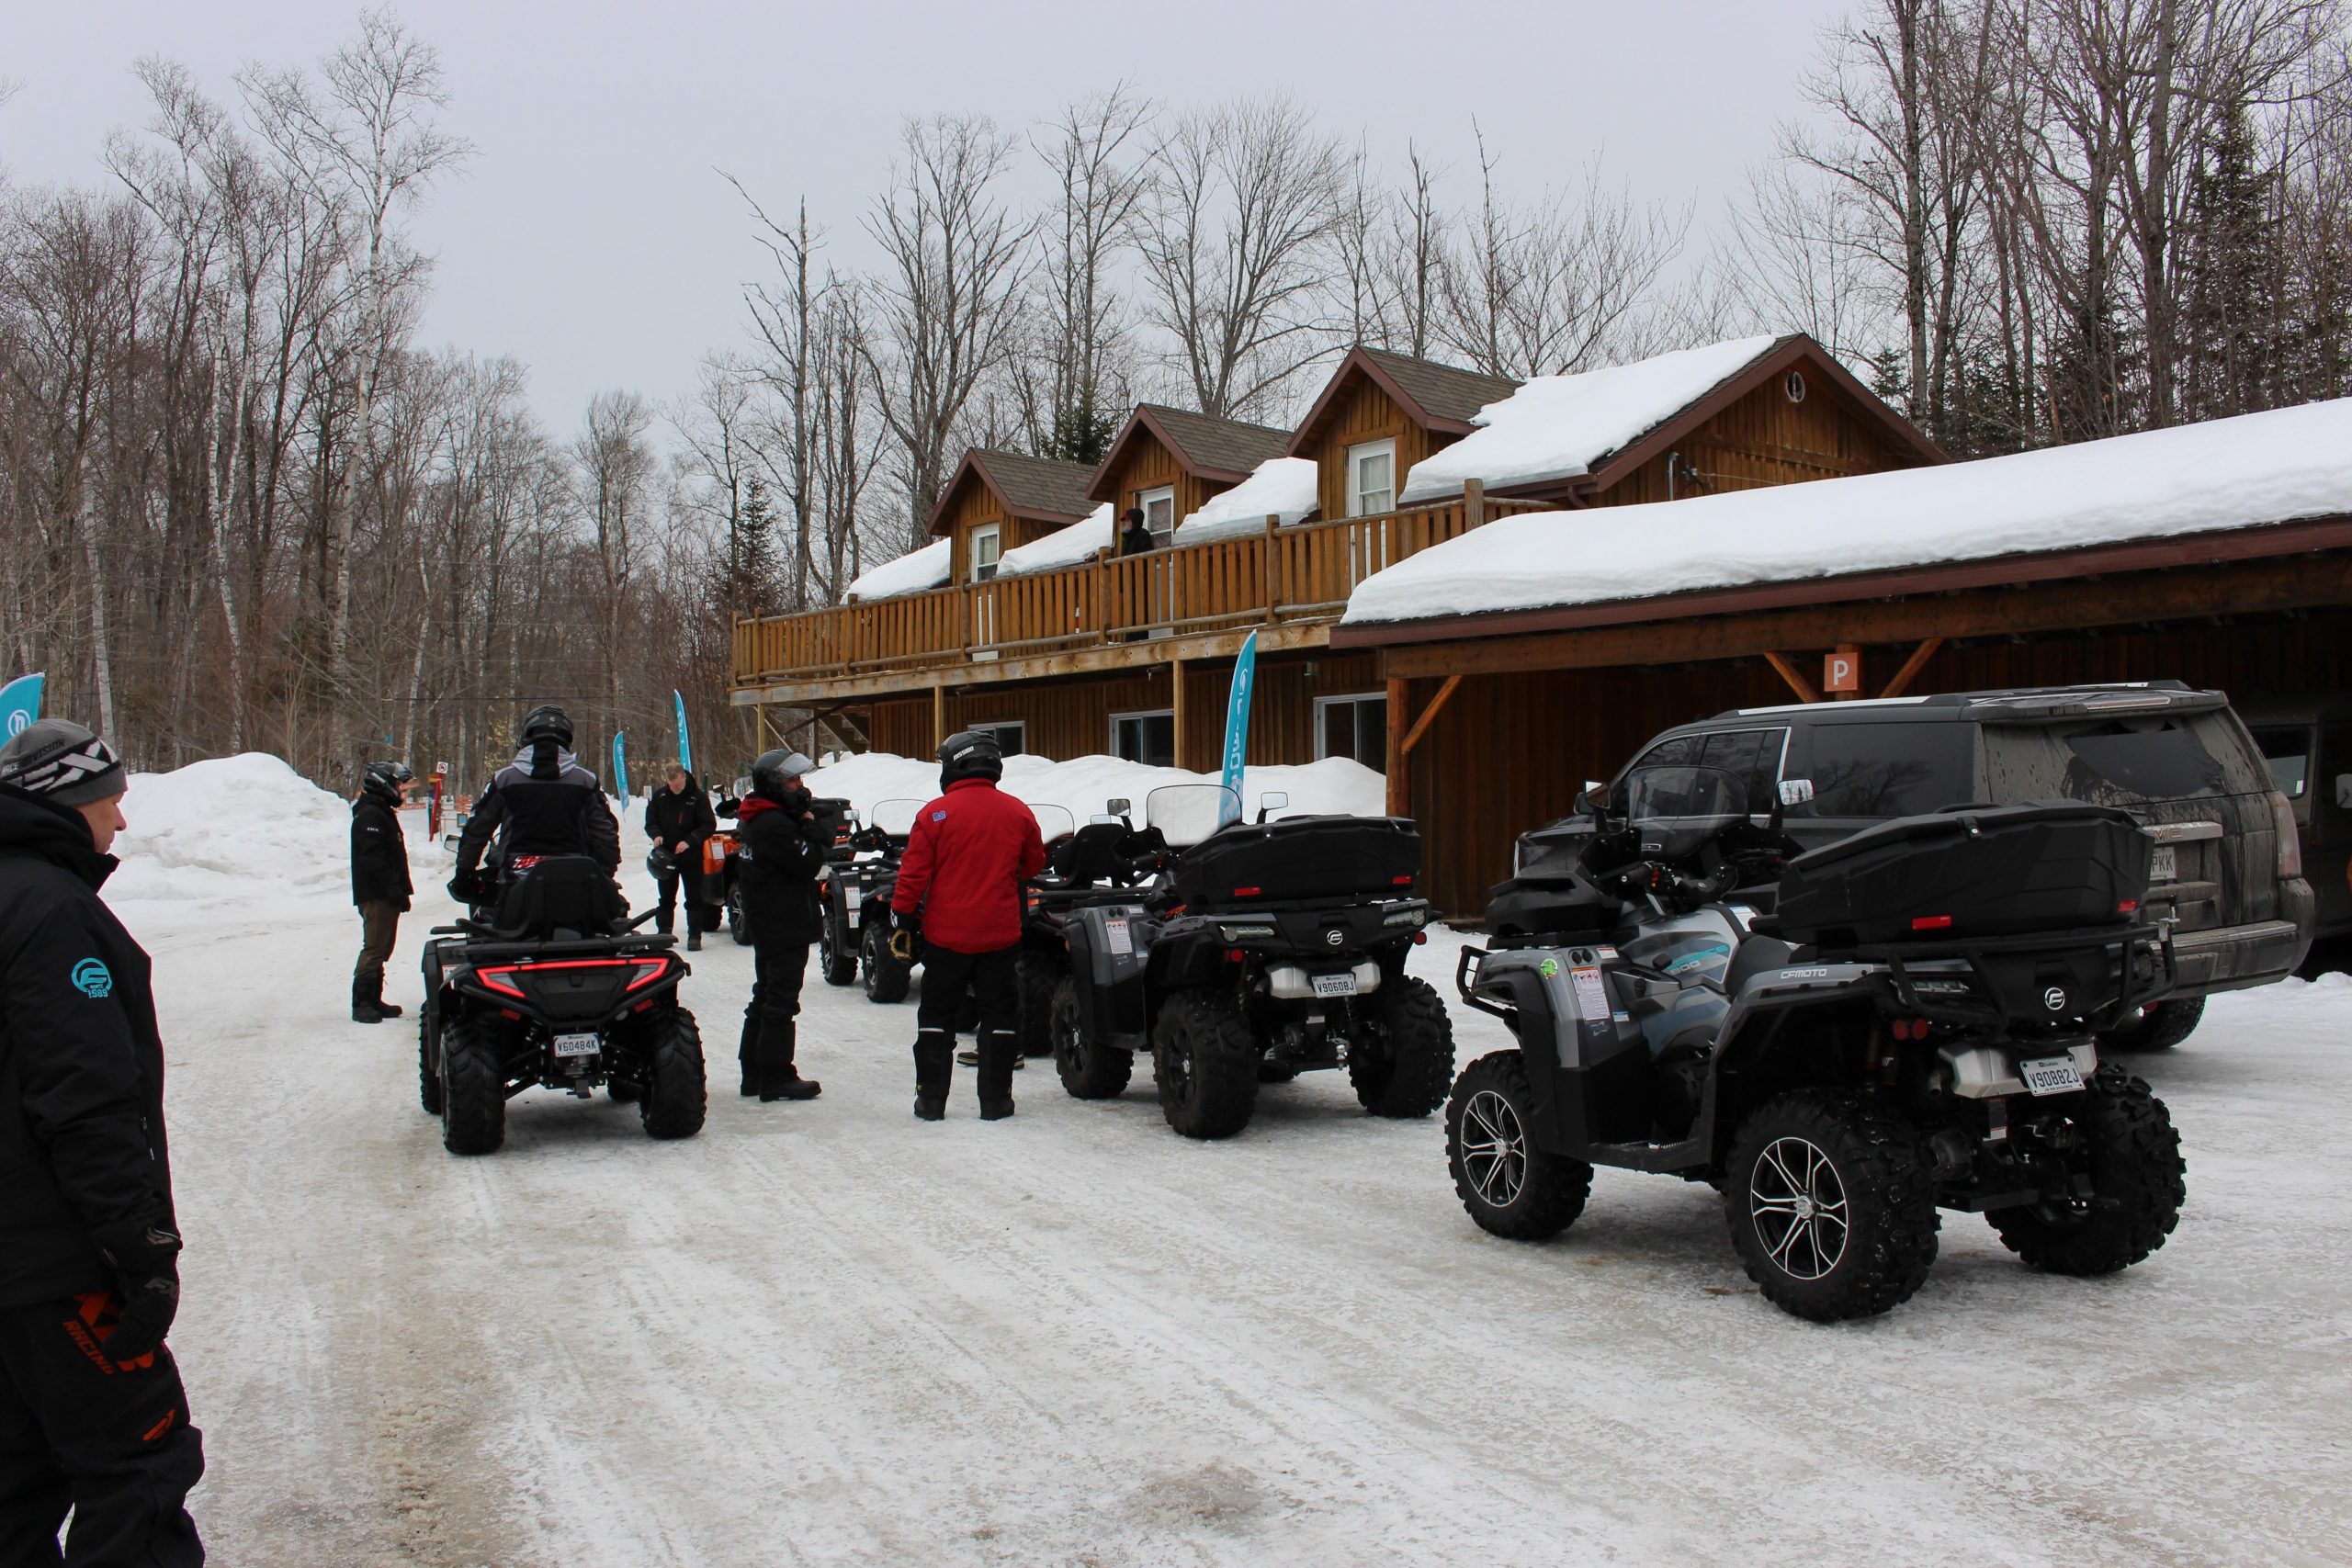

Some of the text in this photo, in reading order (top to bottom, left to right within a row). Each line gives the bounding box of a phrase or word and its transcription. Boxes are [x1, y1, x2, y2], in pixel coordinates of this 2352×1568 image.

[1833, 660, 1849, 685] P
[1781, 968, 1827, 980] CFMOTO
[88, 988, 108, 999] 1989
[557, 1039, 596, 1052] V60484K
[2029, 1067, 2079, 1089] V90882J
[62, 1319, 115, 1375] RACING
